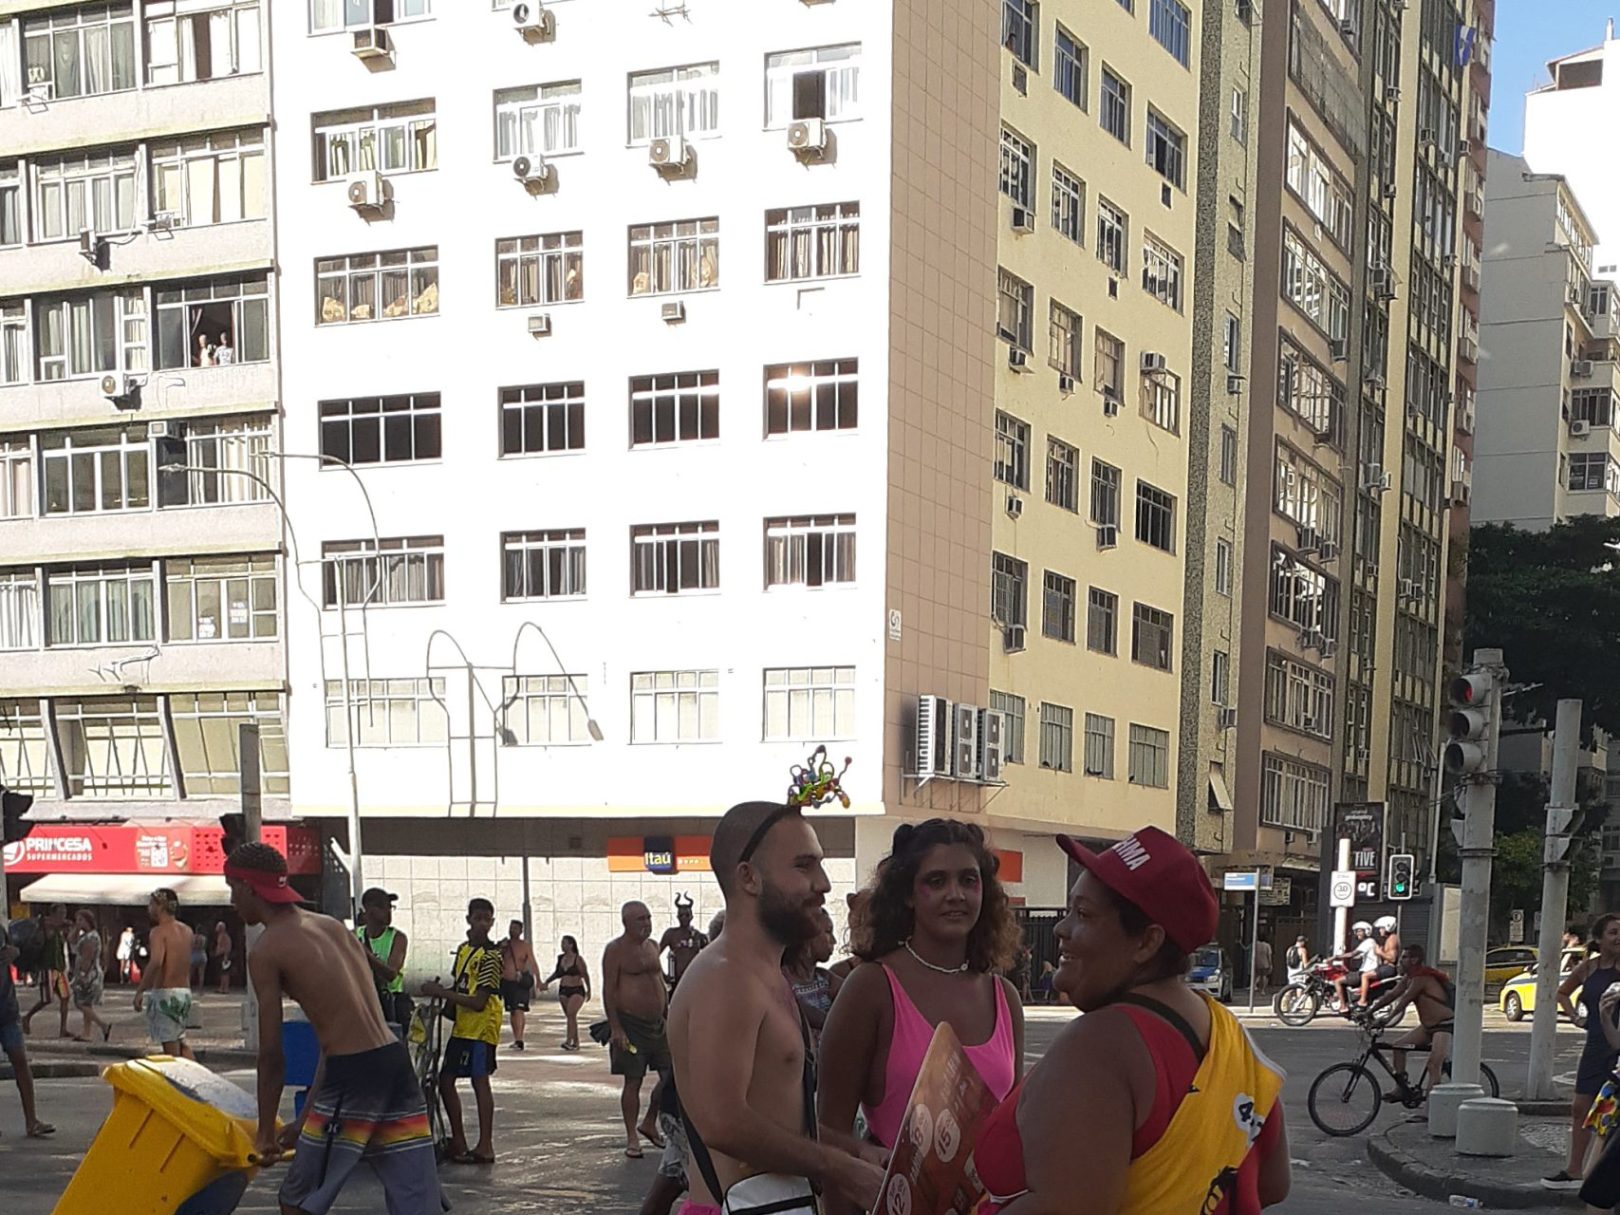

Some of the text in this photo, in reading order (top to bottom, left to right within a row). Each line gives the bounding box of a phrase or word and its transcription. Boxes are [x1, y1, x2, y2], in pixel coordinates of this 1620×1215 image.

[26, 838, 92, 851] PRINCESA
[26, 853, 92, 861] SUPERMERCADOS
[645, 851, 671, 865] Itaú
